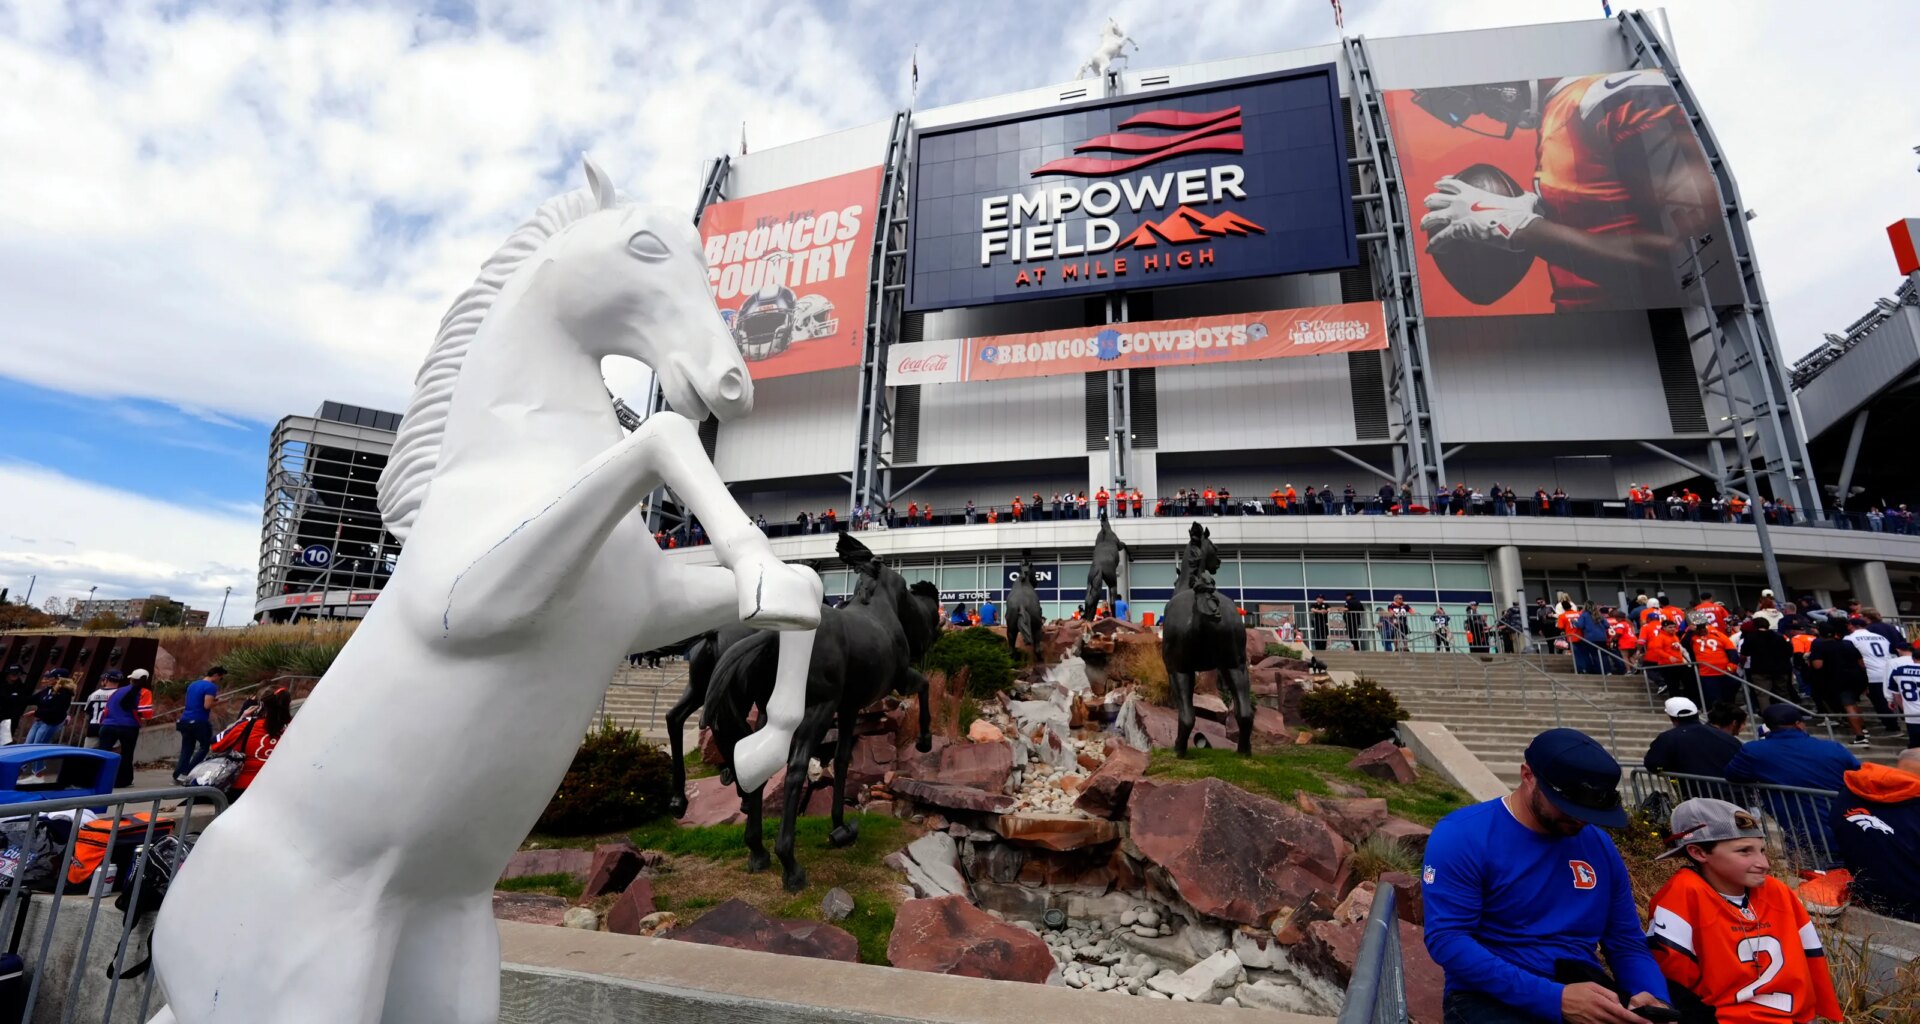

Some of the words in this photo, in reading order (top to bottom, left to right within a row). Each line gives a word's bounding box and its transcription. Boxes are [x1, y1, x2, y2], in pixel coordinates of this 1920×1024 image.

[981, 164, 1247, 231] EMPOWER
[756, 215, 779, 230] We
[787, 208, 814, 224] Are
[704, 204, 863, 267] BRONCOS
[981, 217, 1121, 266] FIELD
[708, 239, 855, 299] COUNTRY
[1015, 267, 1045, 286] AT
[1062, 257, 1127, 282] MILE
[1144, 248, 1214, 272] HIGH
[1313, 320, 1362, 331] Vamos
[997, 337, 1099, 365] BRONCOS
[1117, 324, 1247, 353] COWBOYS
[307, 549, 328, 563] 10
[1009, 571, 1052, 581] OEN
[958, 592, 991, 600] STORE
[1696, 638, 1718, 652] 79
[1870, 642, 1885, 657] 0
[1901, 680, 1920, 702] 8
[1736, 935, 1793, 1013] 2
